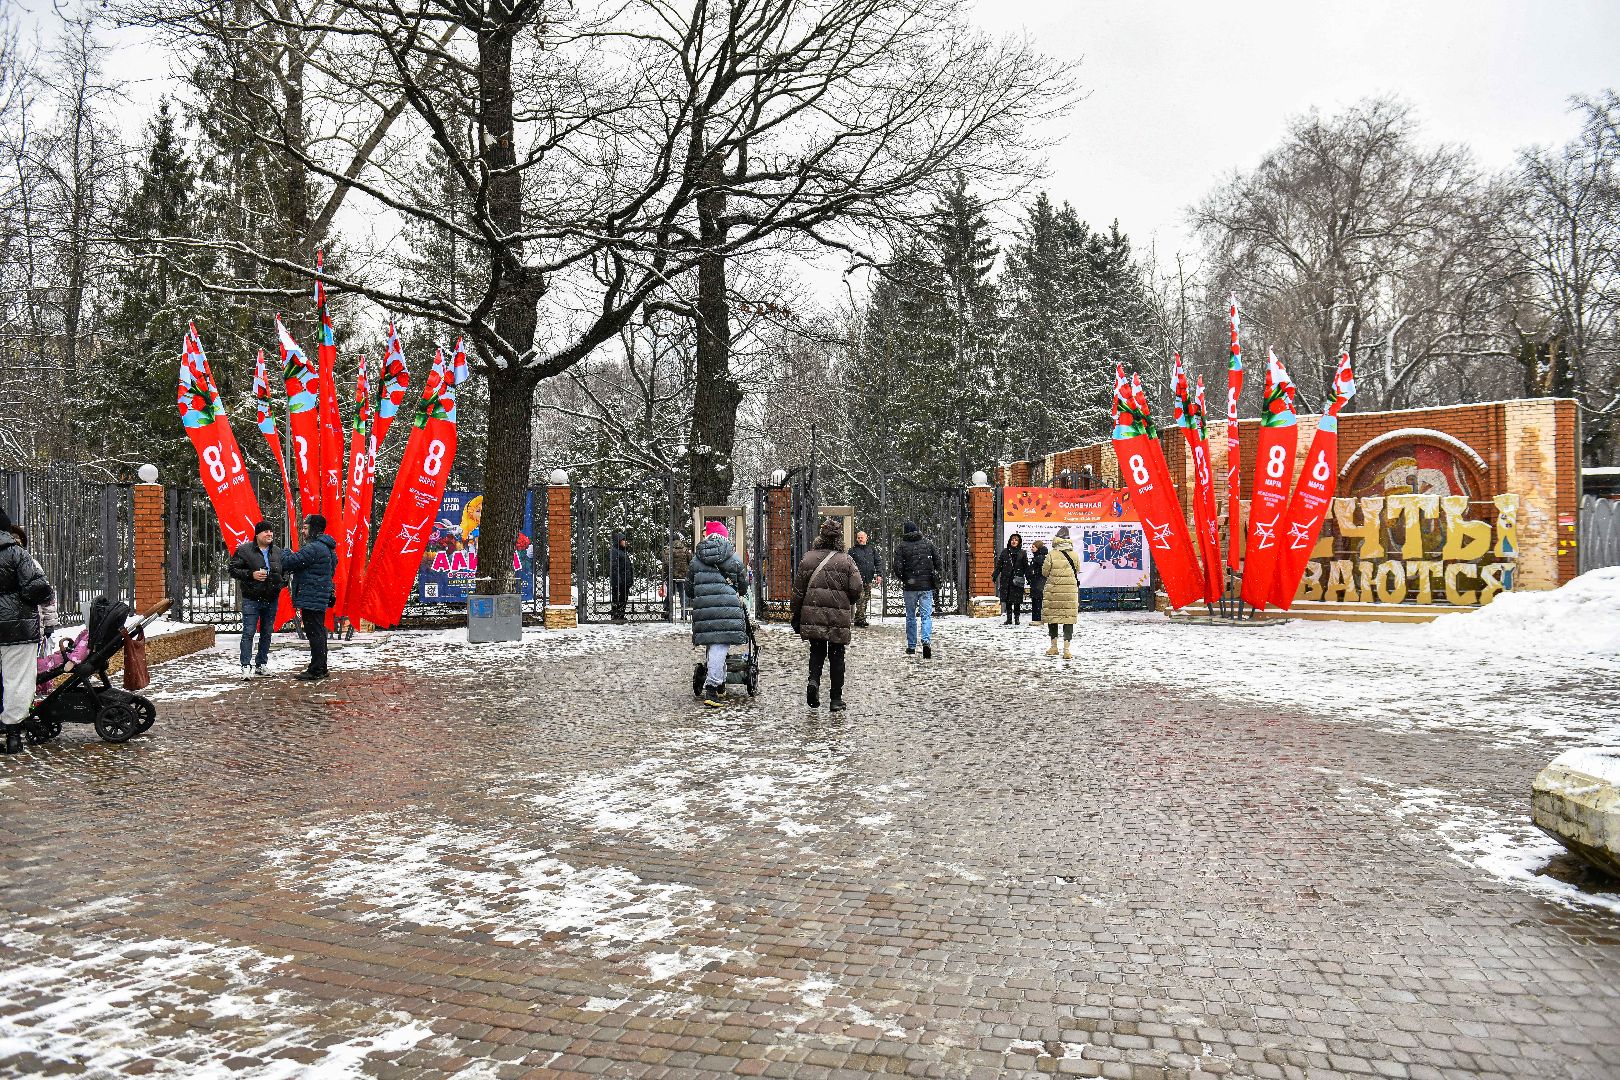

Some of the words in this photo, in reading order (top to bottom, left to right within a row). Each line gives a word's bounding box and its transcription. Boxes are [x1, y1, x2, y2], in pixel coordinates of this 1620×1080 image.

[203, 446, 226, 482] 8
[353, 453, 364, 485] 8
[424, 440, 446, 476] 8
[1267, 445, 1286, 478] 8
